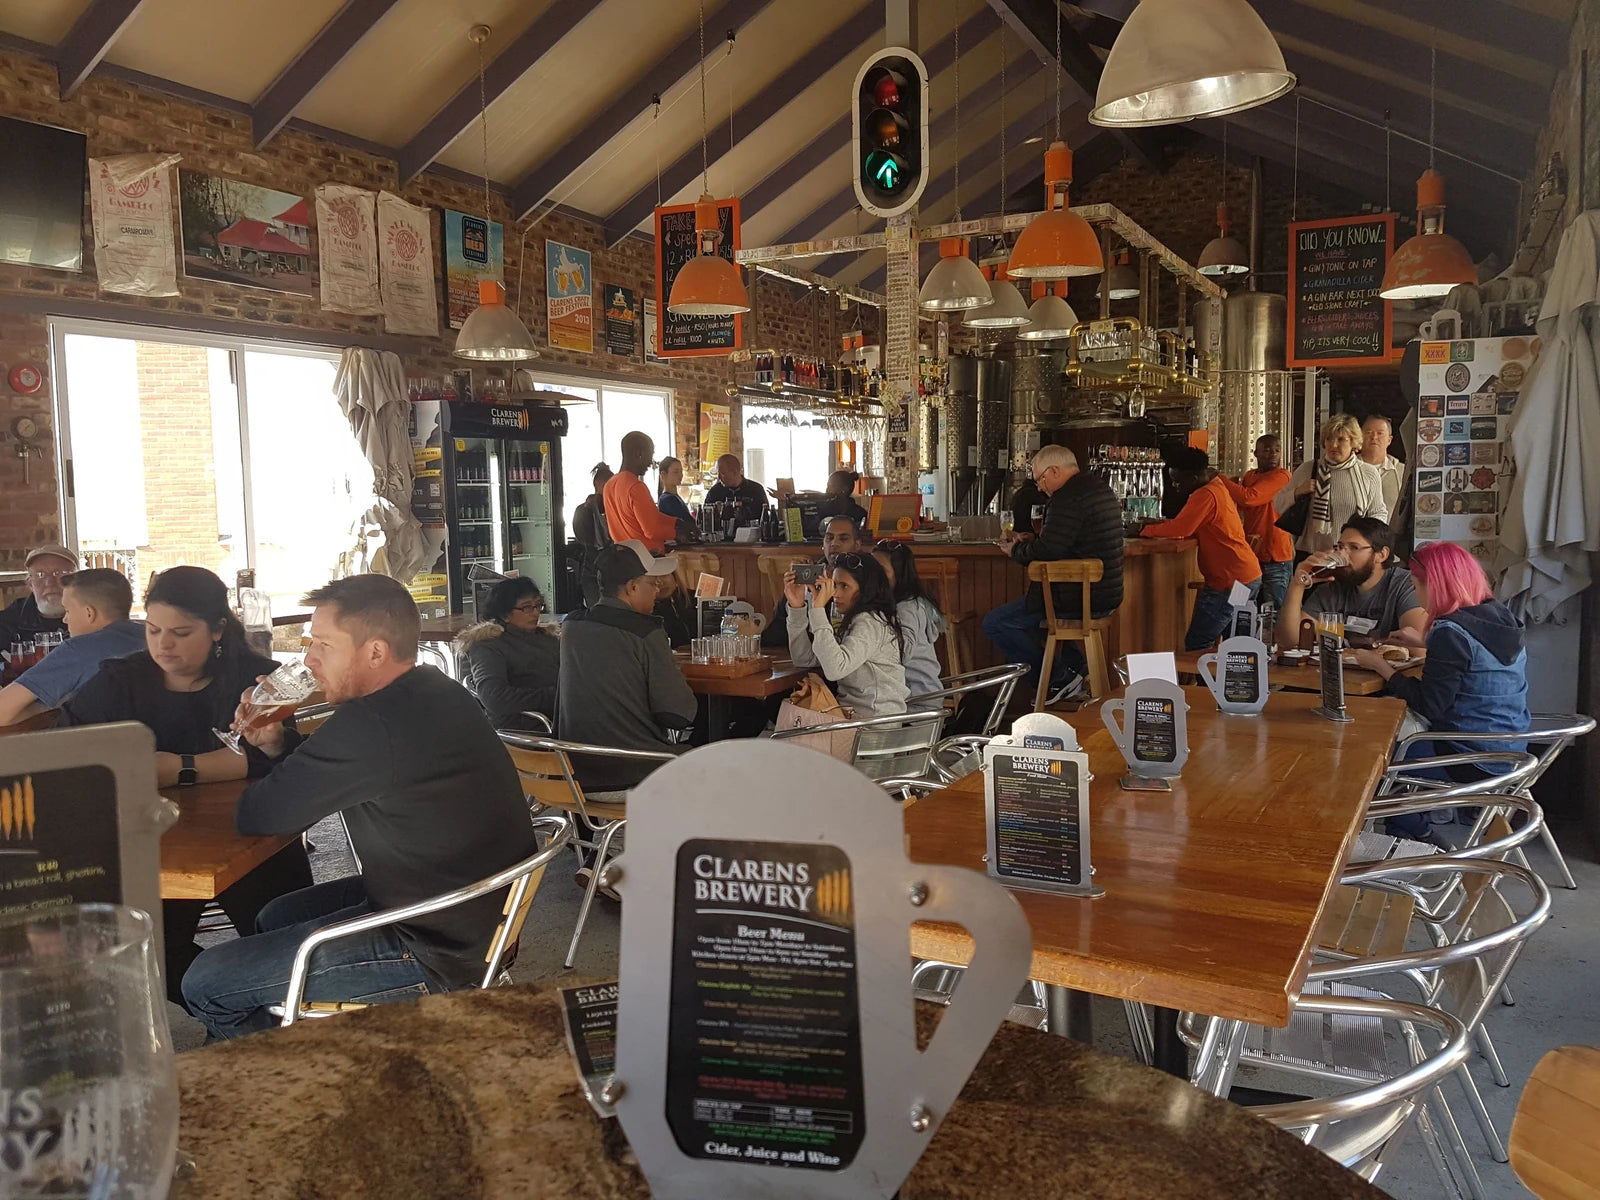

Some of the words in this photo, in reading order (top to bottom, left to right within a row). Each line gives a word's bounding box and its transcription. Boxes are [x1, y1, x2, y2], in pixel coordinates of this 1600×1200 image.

[1300, 231, 1318, 251] DID
[1322, 228, 1343, 249] YOU
[1308, 263, 1321, 273] GIN
[1326, 261, 1345, 272] TONIC
[1348, 260, 1359, 270] ON
[1362, 257, 1378, 268] TAP
[550, 297, 574, 307] CLARENS
[1314, 292, 1328, 302] GIN
[1328, 290, 1344, 300] BAR
[1346, 289, 1365, 300] NEXT
[550, 307, 564, 316] BEER
[565, 300, 590, 311] FESTIVAL
[1425, 349, 1446, 359] XXXX
[1025, 739, 1053, 747] CLARENS
[1012, 755, 1049, 766] CLARENS
[1012, 762, 1050, 774] BREWERY
[693, 854, 810, 885] CLARENS
[694, 879, 814, 912] BREWERY
[737, 924, 768, 939] Beer
[769, 926, 806, 942] Menu
[704, 1141, 743, 1157] Cider,
[744, 1145, 779, 1160] Juice
[781, 1150, 805, 1162] and
[807, 1151, 841, 1166] Wine
